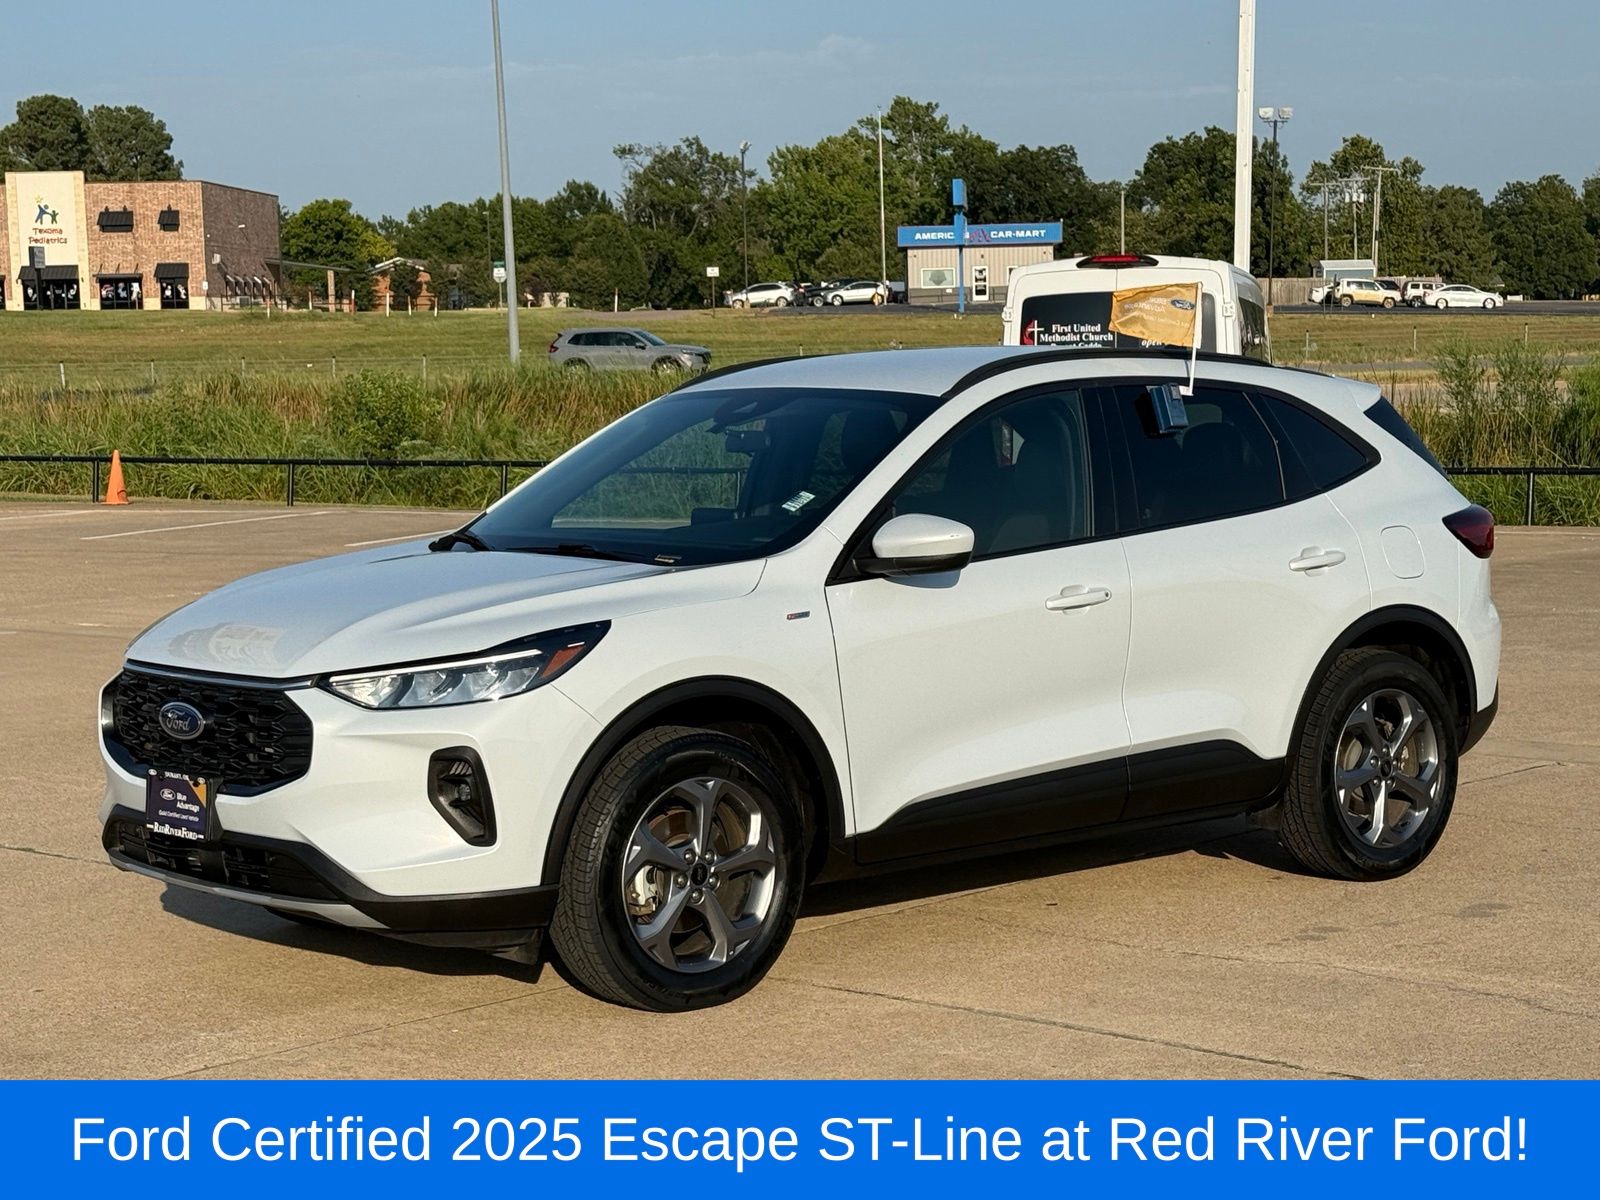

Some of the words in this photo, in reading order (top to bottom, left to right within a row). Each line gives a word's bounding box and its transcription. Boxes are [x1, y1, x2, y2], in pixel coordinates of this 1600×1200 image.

[32, 227, 63, 235] Texoma
[990, 229, 1046, 239] CAR-MART
[28, 236, 68, 245] Pediatrics
[1051, 323, 1072, 333] First
[1073, 323, 1101, 333] United
[1040, 333, 1081, 342] Methodist
[1081, 332, 1114, 341] Church
[164, 709, 192, 730] Ford
[176, 792, 187, 801] Blue
[176, 801, 200, 813] Advantage
